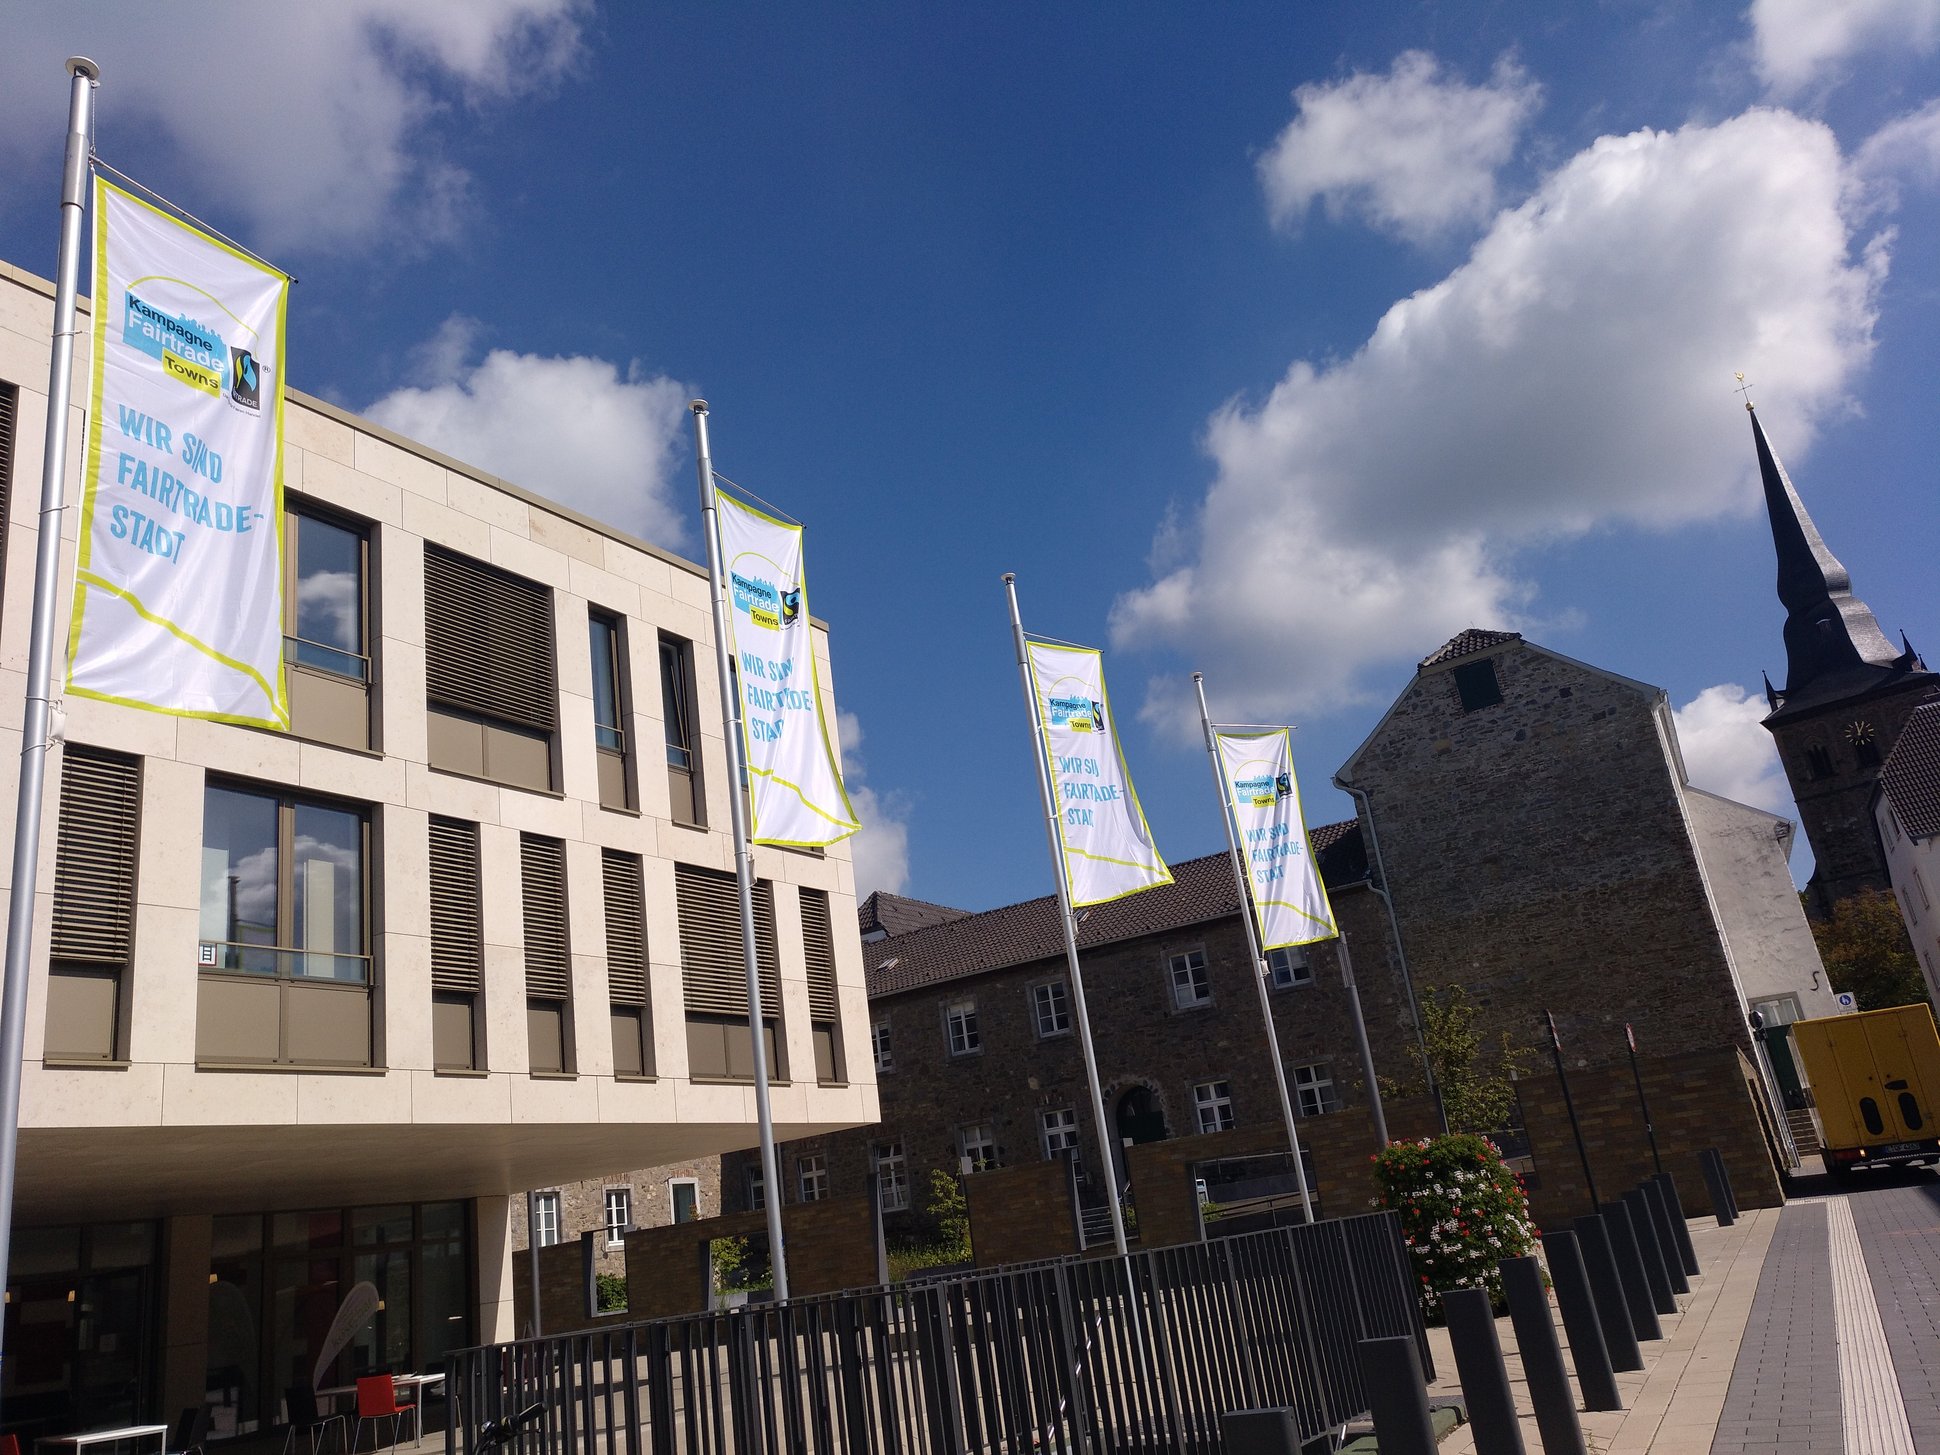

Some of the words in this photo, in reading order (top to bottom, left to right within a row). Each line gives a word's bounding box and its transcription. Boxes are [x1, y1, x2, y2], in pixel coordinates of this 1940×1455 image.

[129, 296, 213, 351] Kampagne
[128, 312, 225, 372] Fairtrade
[165, 355, 219, 390] Towns
[118, 404, 173, 454] WIR
[182, 432, 223, 483] SIND
[110, 504, 185, 564] STADT
[732, 573, 772, 598] Kampagne
[733, 584, 779, 612] Fairtrade
[751, 609, 779, 625] Towns
[741, 650, 766, 679] WIR
[770, 656, 795, 682] SIN
[1049, 699, 1087, 711] Kampagne
[1052, 707, 1092, 718] Fairtrade
[1059, 756, 1082, 774] WIR
[1234, 780, 1270, 788] Kampagne
[1246, 827, 1267, 842] WIR
